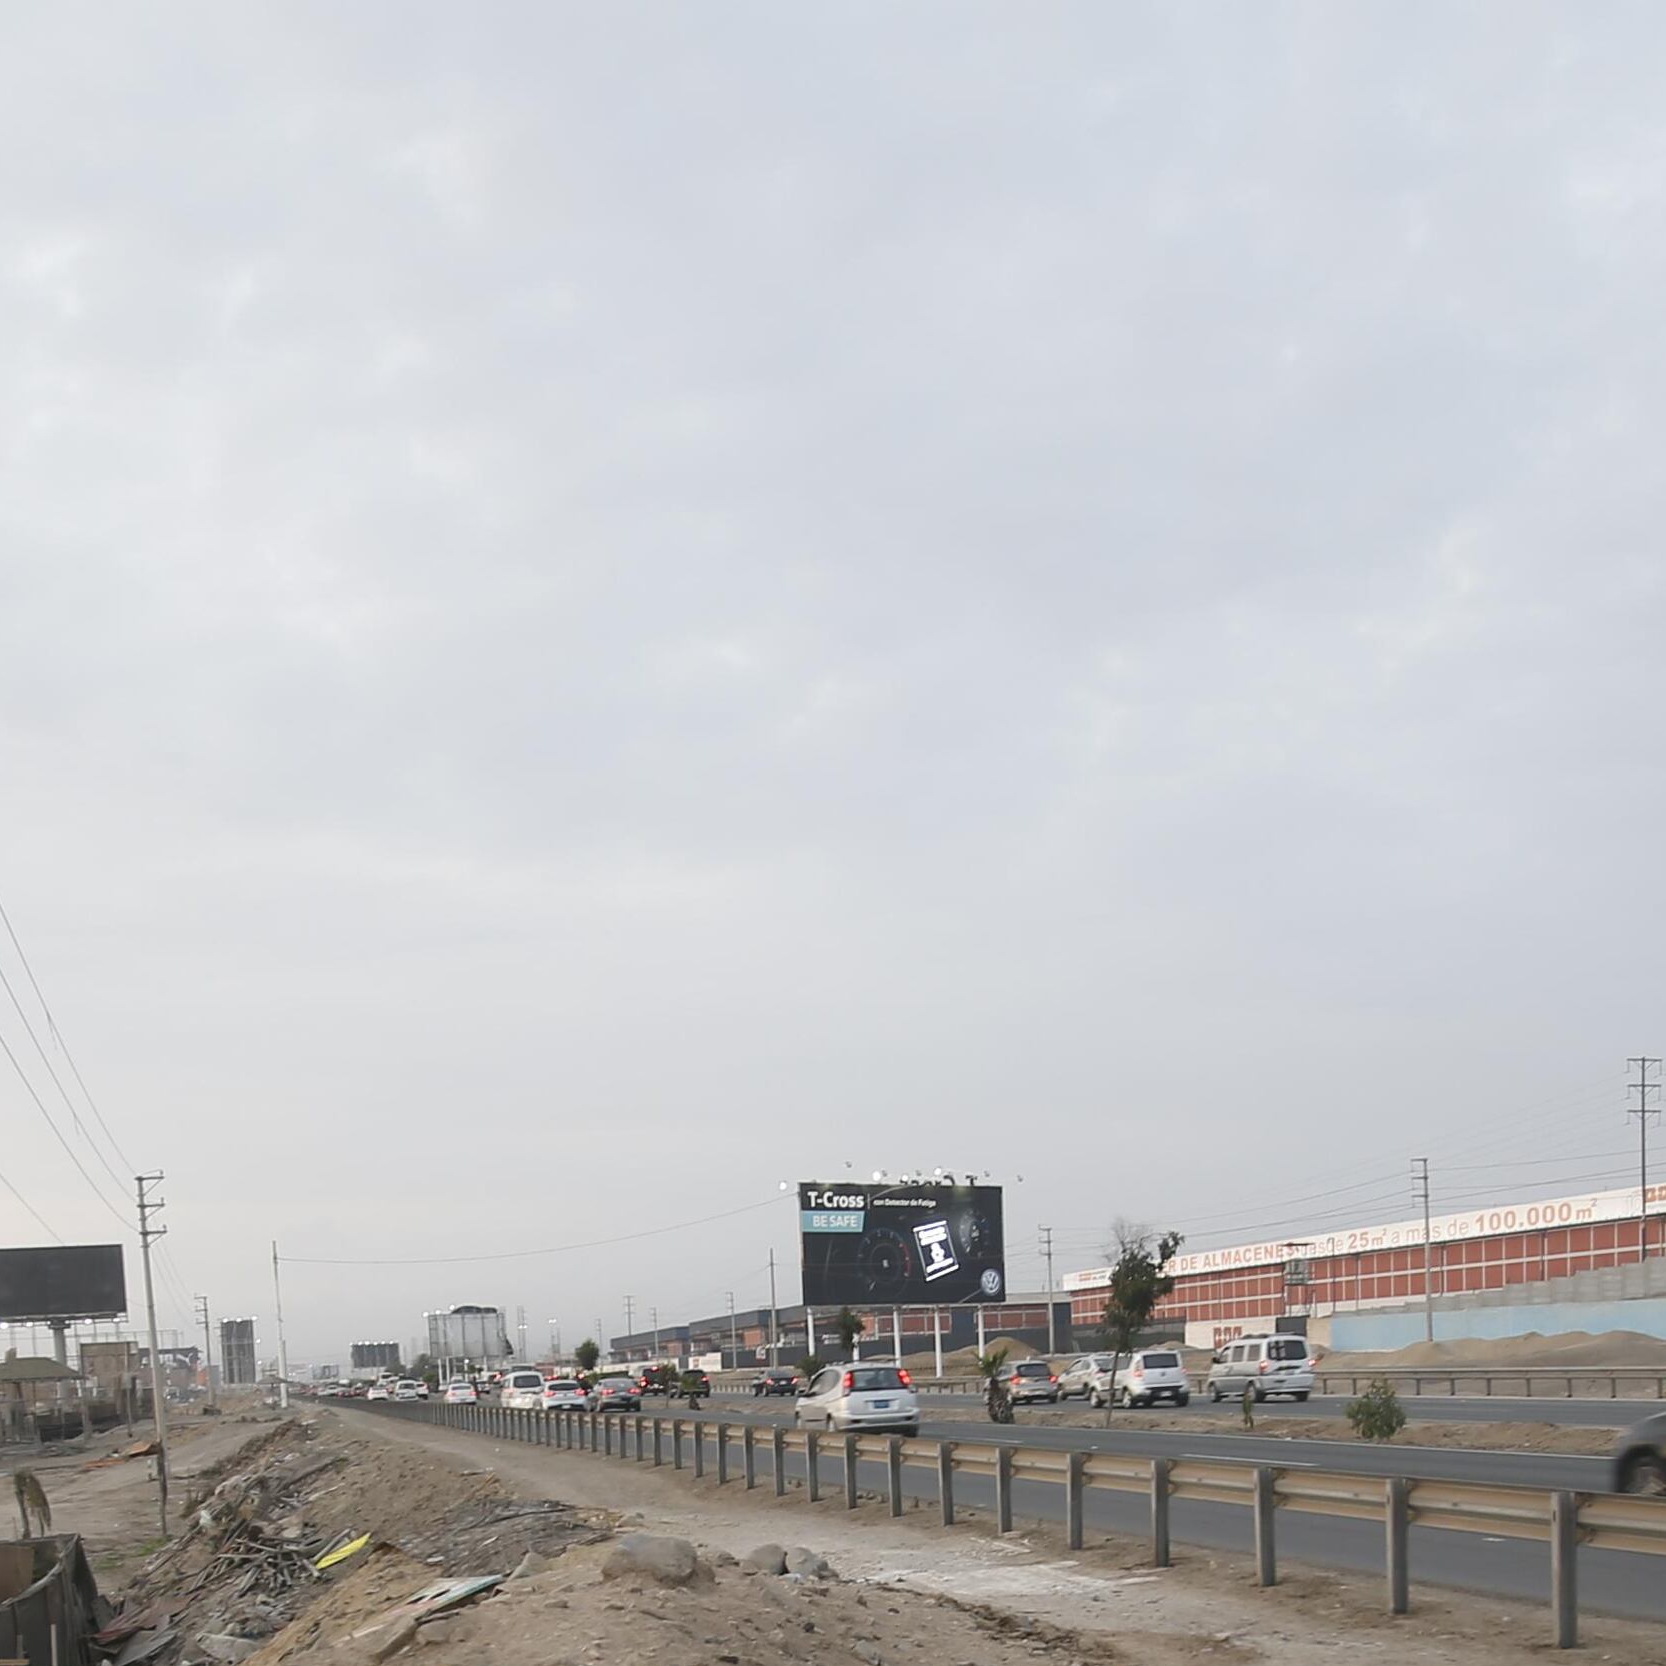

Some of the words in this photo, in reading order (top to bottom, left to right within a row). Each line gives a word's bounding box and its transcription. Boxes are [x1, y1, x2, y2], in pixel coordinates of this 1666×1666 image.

[807, 1192, 864, 1208] T-Cross
[813, 1215, 828, 1227] BE
[829, 1215, 857, 1227] SAFE
[1180, 1256, 1197, 1270] DE
[1203, 1243, 1294, 1268] ALMACENES
[1447, 1220, 1469, 1236] de
